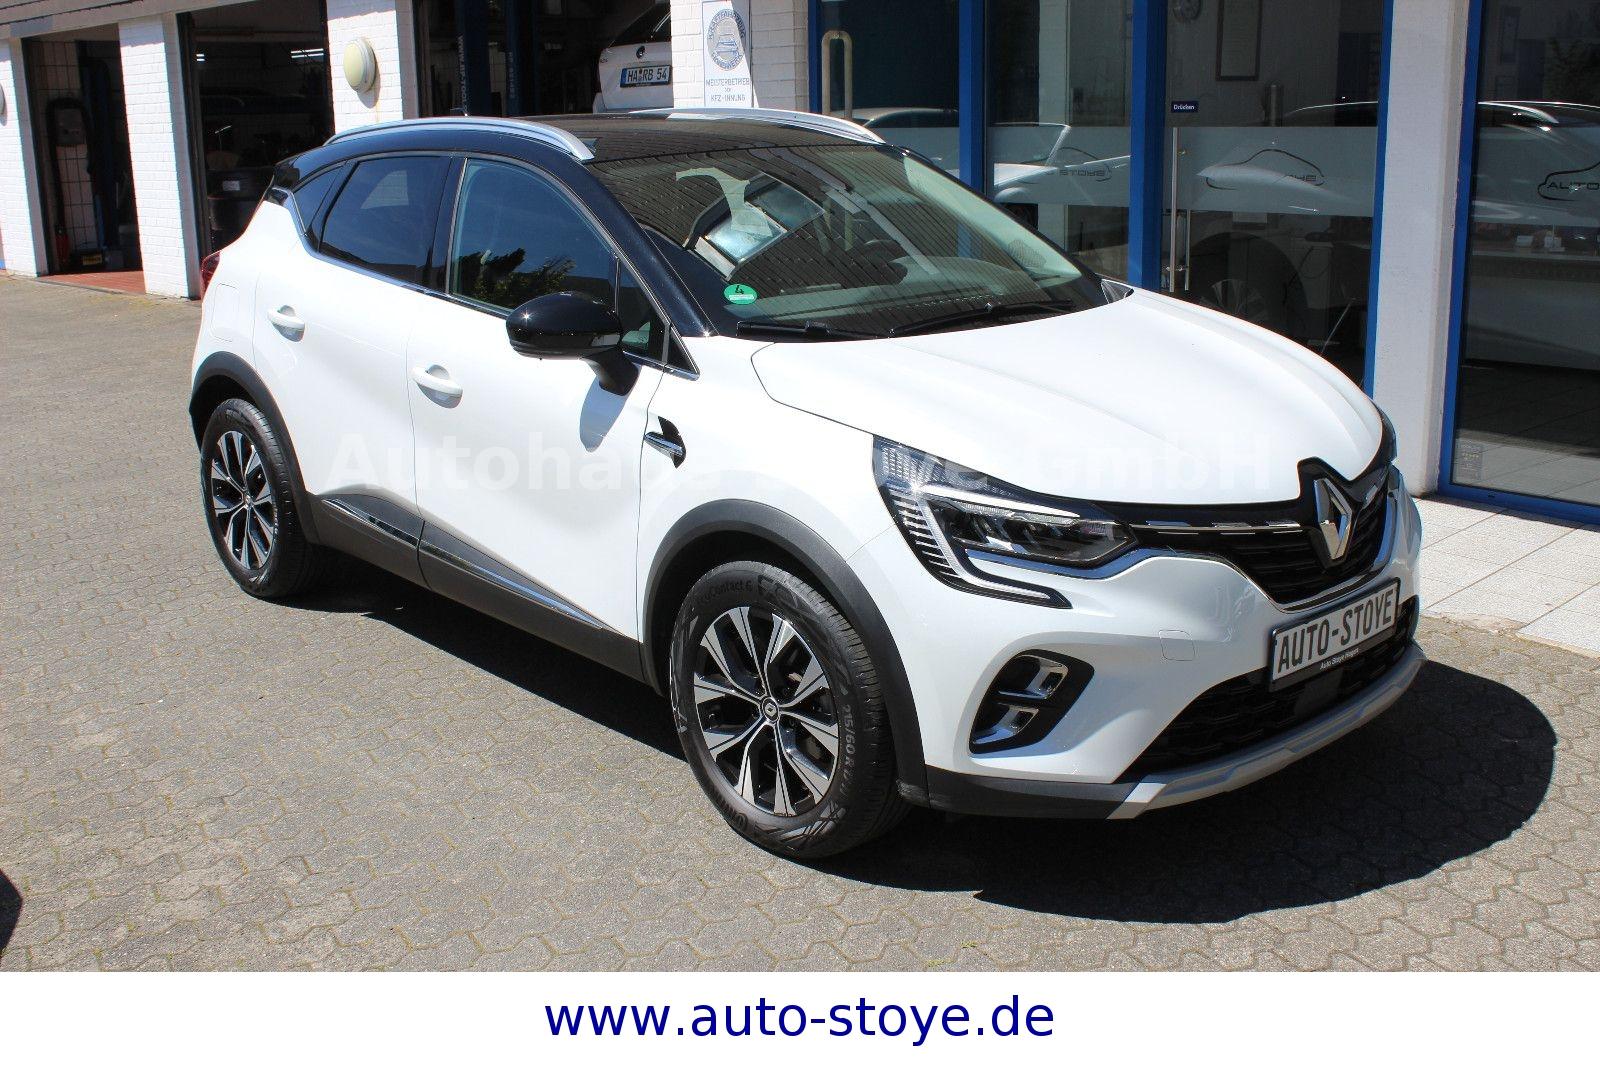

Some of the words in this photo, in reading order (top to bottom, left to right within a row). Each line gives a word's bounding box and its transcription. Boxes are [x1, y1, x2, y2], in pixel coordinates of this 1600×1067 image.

[627, 70, 638, 82] HA
[642, 69, 653, 81] RB
[656, 66, 667, 80] 54
[1278, 589, 1393, 673] AUTO-STOYE
